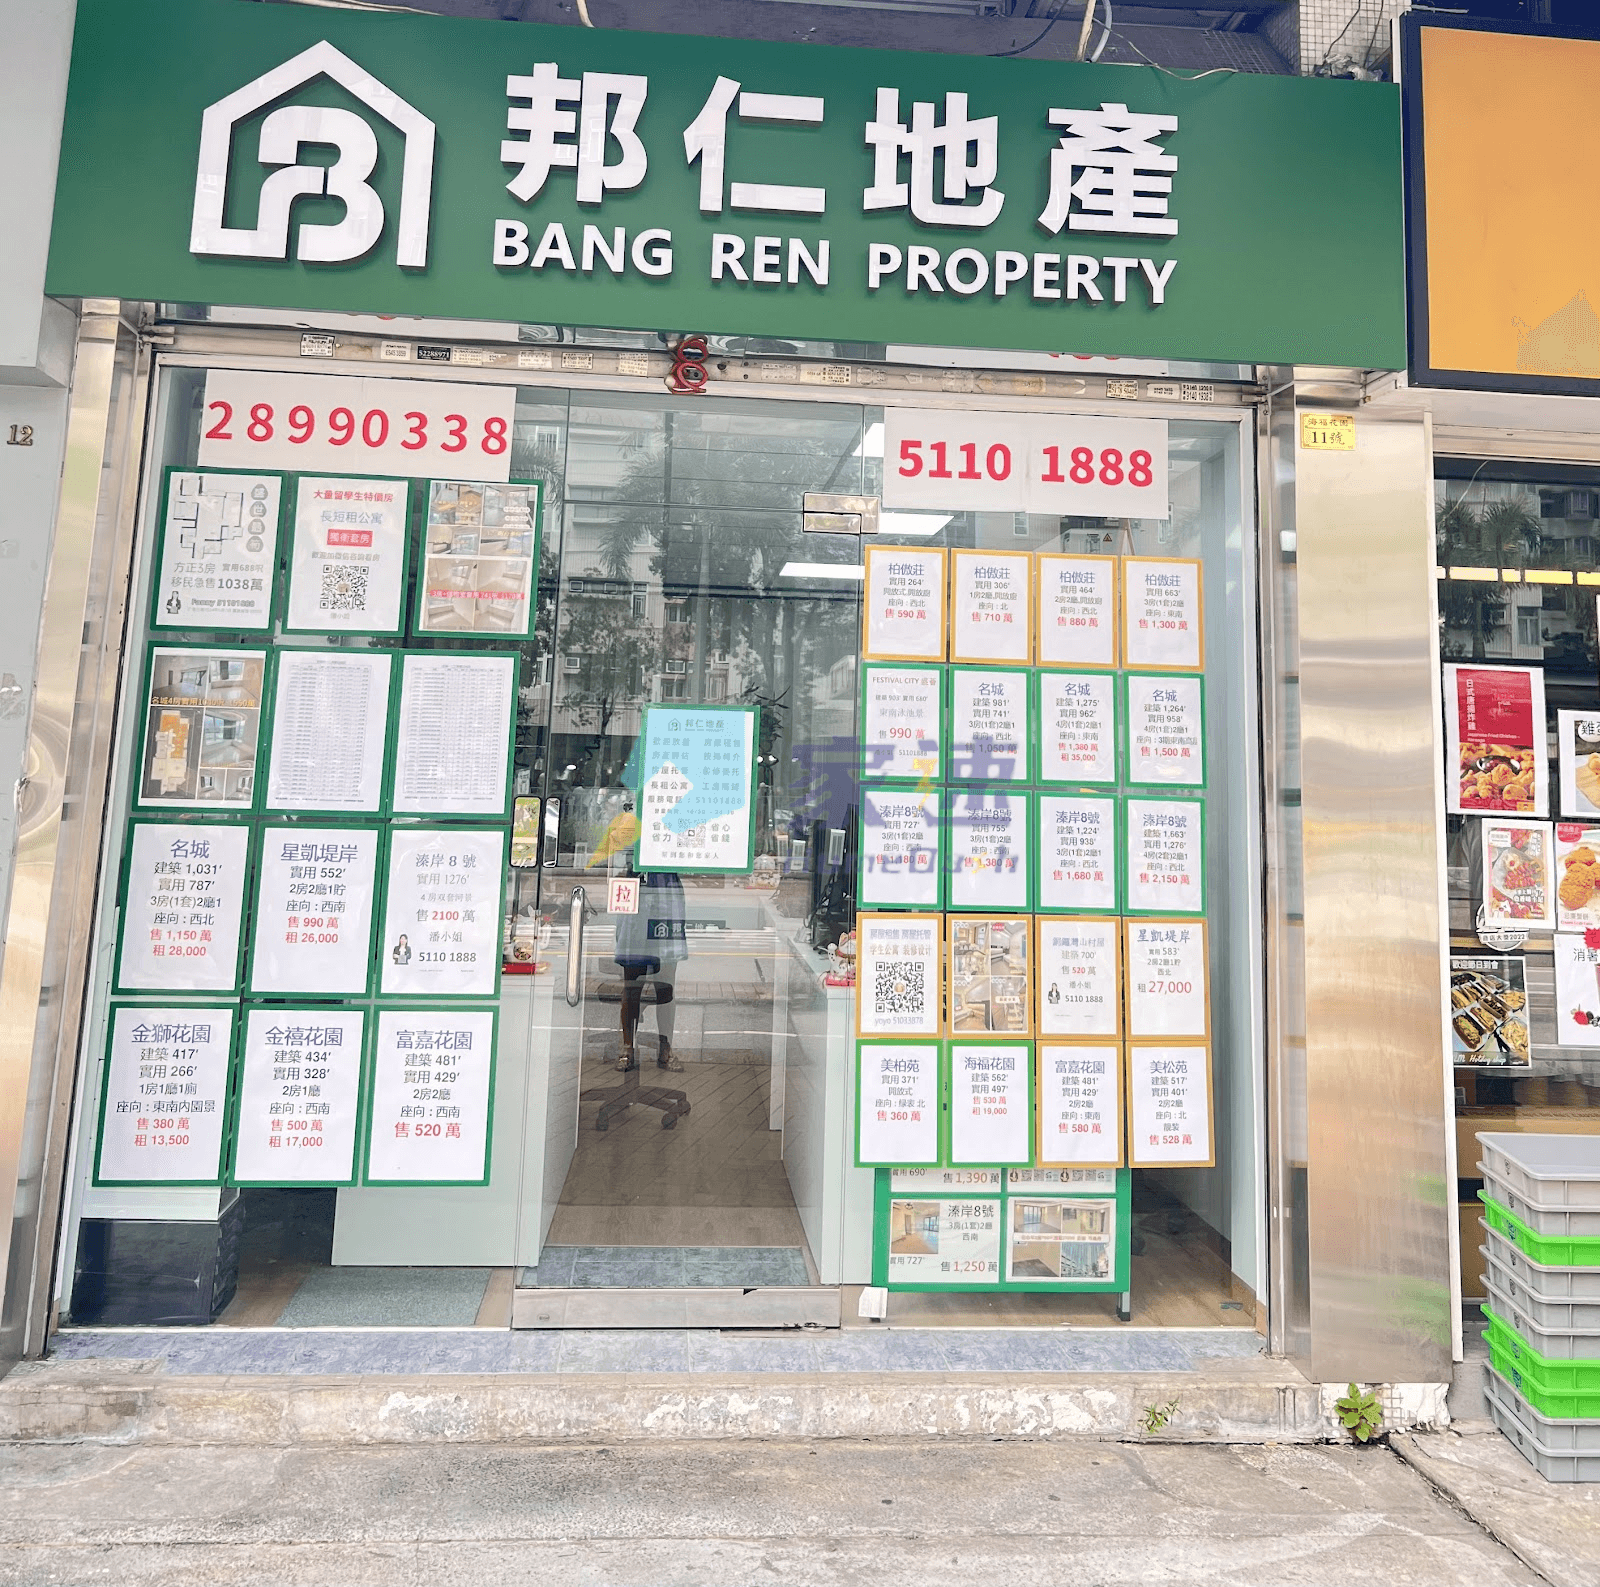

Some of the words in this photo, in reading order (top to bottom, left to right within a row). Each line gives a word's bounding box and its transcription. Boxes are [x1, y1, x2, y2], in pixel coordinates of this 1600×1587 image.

[500, 62, 1181, 236] 邦仁地產
[493, 218, 673, 277] BANG
[711, 233, 830, 287] REN
[867, 243, 1178, 306] PROPERTY
[205, 399, 508, 456] 28990338
[7, 424, 33, 446] 12
[899, 439, 1011, 481] 5110
[1041, 445, 1153, 487] 1888
[314, 490, 393, 502] 大量留學生特價房
[321, 511, 383, 524] 長短租公寓
[174, 562, 215, 574] 方正3房
[889, 563, 924, 576] 柏傲莊
[974, 567, 1010, 579] 柏傲莊
[171, 577, 215, 588] 移民急售
[218, 579, 263, 591] 1038萬
[1060, 571, 1095, 584] 柏傲莊
[1145, 574, 1181, 586] 柏傲莊
[885, 609, 894, 618] 售
[898, 610, 914, 618] 590
[979, 683, 1004, 695] 名城
[1065, 683, 1090, 696] 名城
[1153, 690, 1177, 701] 名城
[890, 728, 911, 738] 990
[651, 782, 688, 790] 長租公寓
[1056, 811, 1100, 824] 溱岸8號
[1143, 814, 1187, 827] 溱岸8號
[653, 833, 671, 842] 省力
[170, 839, 210, 858] 名城
[281, 843, 358, 863] 星凱堤岸
[416, 854, 444, 868] 溱岸
[449, 855, 457, 866] 8
[463, 854, 477, 868] 號
[154, 862, 182, 874] 建築
[290, 866, 316, 879] 實用
[417, 873, 440, 885] 實用
[1139, 873, 1149, 883] 售
[1153, 875, 1177, 883] 2,150
[158, 878, 185, 892] 實用
[616, 885, 630, 902] 拉
[416, 909, 428, 922] 售
[432, 911, 459, 920] 2100
[462, 910, 475, 922] 萬
[288, 917, 299, 928] 售
[304, 918, 323, 927] 990
[327, 917, 338, 928] 萬
[151, 929, 162, 940] 售
[167, 931, 196, 941] 1,150
[200, 930, 212, 941] 萬
[286, 932, 297, 943] 租
[302, 933, 338, 944] 26,000
[430, 931, 462, 942] 潘小姐
[1137, 929, 1190, 943] 星凱堤岸
[153, 945, 165, 956] 租
[169, 946, 206, 956] 28,000
[419, 952, 446, 962] 5110
[450, 953, 476, 962] 1888
[1138, 983, 1146, 993] 租
[1149, 981, 1192, 994] 27,000
[875, 1018, 891, 1026] yoyo
[132, 1024, 211, 1043] 金獅花園
[265, 1026, 343, 1046] 金禧花園
[397, 1030, 473, 1050] 富嘉花園
[141, 1048, 168, 1061] 建築
[274, 1050, 302, 1063] 建築
[405, 1053, 432, 1066] 建築
[881, 1058, 919, 1072] 美柏苑
[965, 1057, 1015, 1071] 海福花園
[1055, 1061, 1105, 1074] 富嘉花園
[1150, 1061, 1187, 1074] 美松苑
[139, 1065, 167, 1078] 實用
[273, 1067, 300, 1080] 實用
[404, 1070, 430, 1083] 實用
[282, 1085, 321, 1097] 2房1廳
[413, 1088, 451, 1100] 2房2廳
[137, 1118, 148, 1130] 售
[153, 1119, 174, 1128] 380
[177, 1118, 190, 1130] 萬
[271, 1120, 283, 1131] 售
[287, 1121, 307, 1130] 500
[311, 1120, 323, 1131] 萬
[395, 1122, 410, 1138] 售
[415, 1124, 441, 1136] 520
[446, 1123, 462, 1138] 萬
[134, 1134, 147, 1146] 租
[152, 1135, 189, 1146] 13,500
[269, 1136, 281, 1147] 租
[286, 1137, 323, 1148] 17,000
[943, 1173, 952, 1183] 售
[956, 1173, 987, 1184] 1,390
[990, 1173, 999, 1183] 萬
[948, 1205, 994, 1217] 溱岸8號
